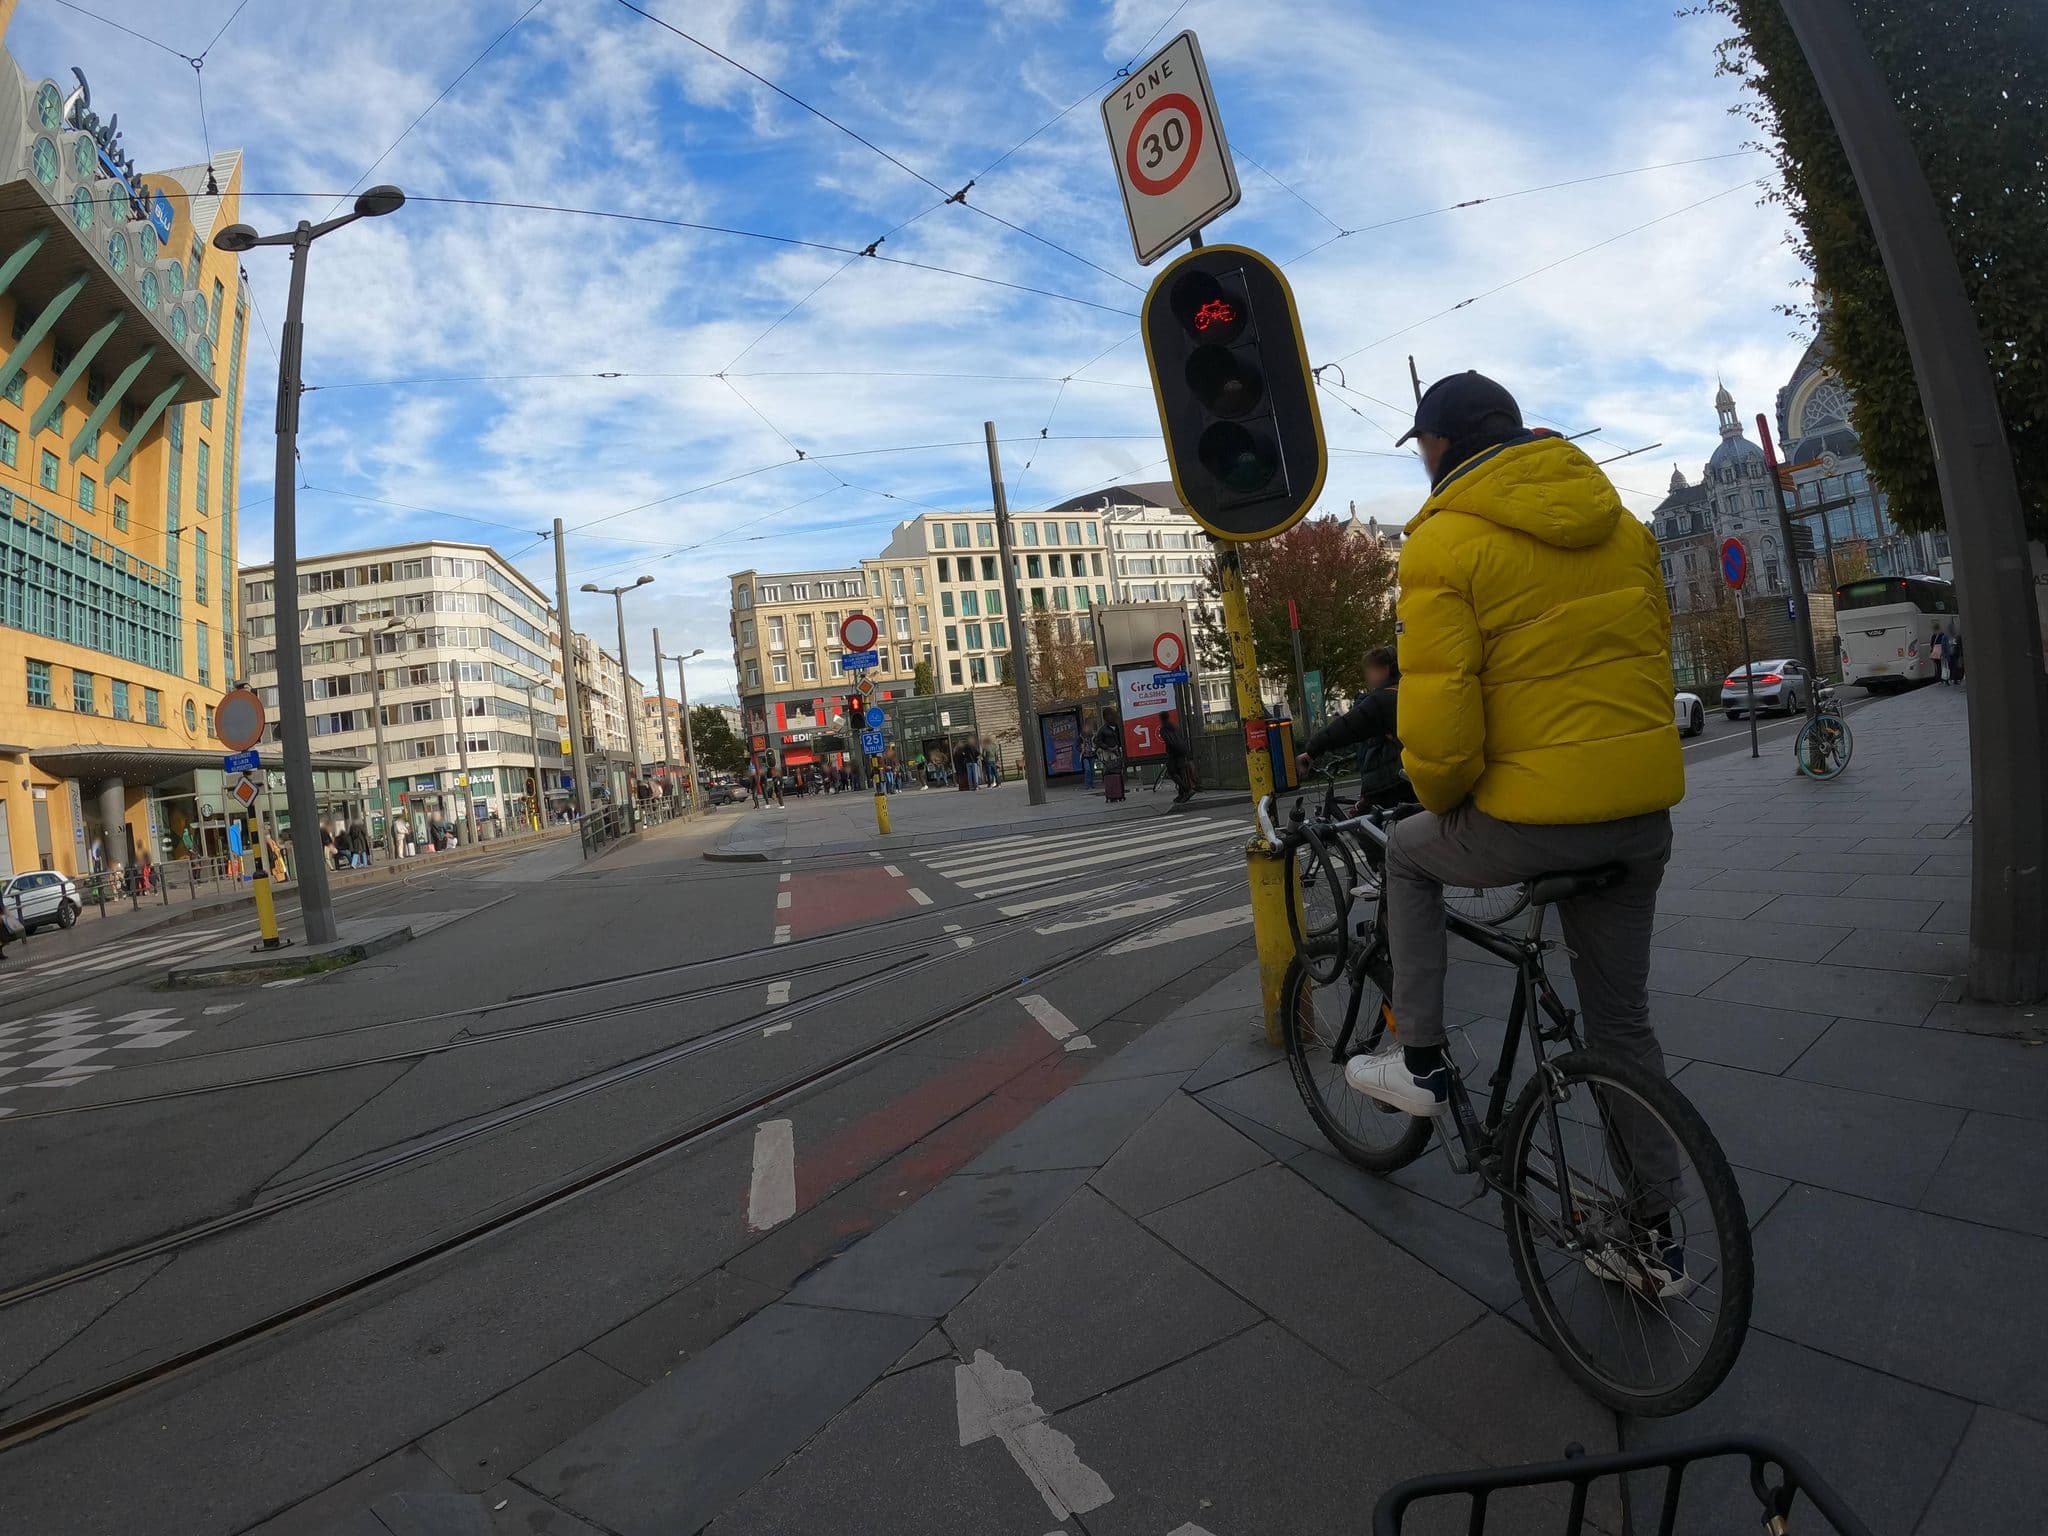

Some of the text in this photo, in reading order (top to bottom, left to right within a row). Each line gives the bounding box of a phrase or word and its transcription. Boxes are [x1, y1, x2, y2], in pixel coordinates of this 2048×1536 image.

[1122, 59, 1174, 111] ZONE
[1142, 117, 1184, 169] 30
[1138, 690, 1167, 699] CASINO
[866, 734, 880, 745] 25
